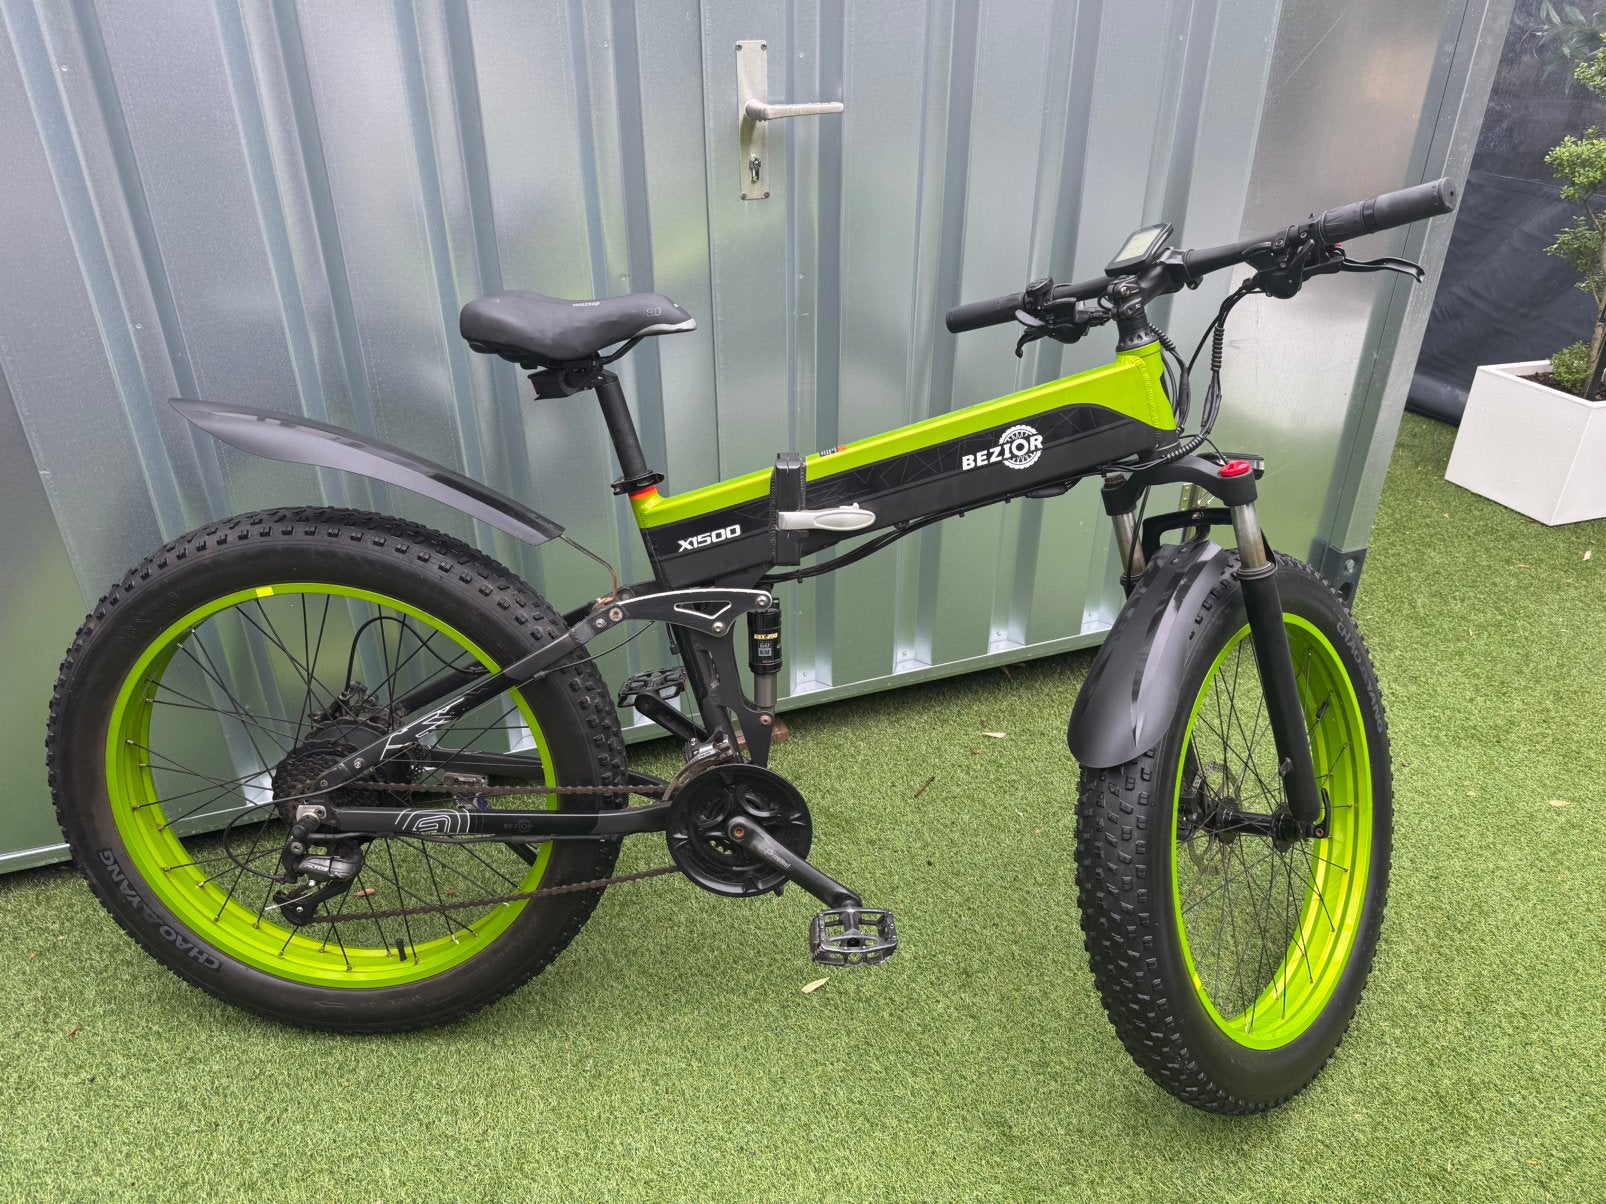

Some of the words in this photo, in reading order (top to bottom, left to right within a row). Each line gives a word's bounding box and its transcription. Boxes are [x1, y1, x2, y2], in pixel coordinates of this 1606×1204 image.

[962, 434, 1043, 471] BEZIOR
[677, 524, 741, 553] X1500
[99, 849, 142, 909] YANG
[159, 925, 221, 969] CHAO
